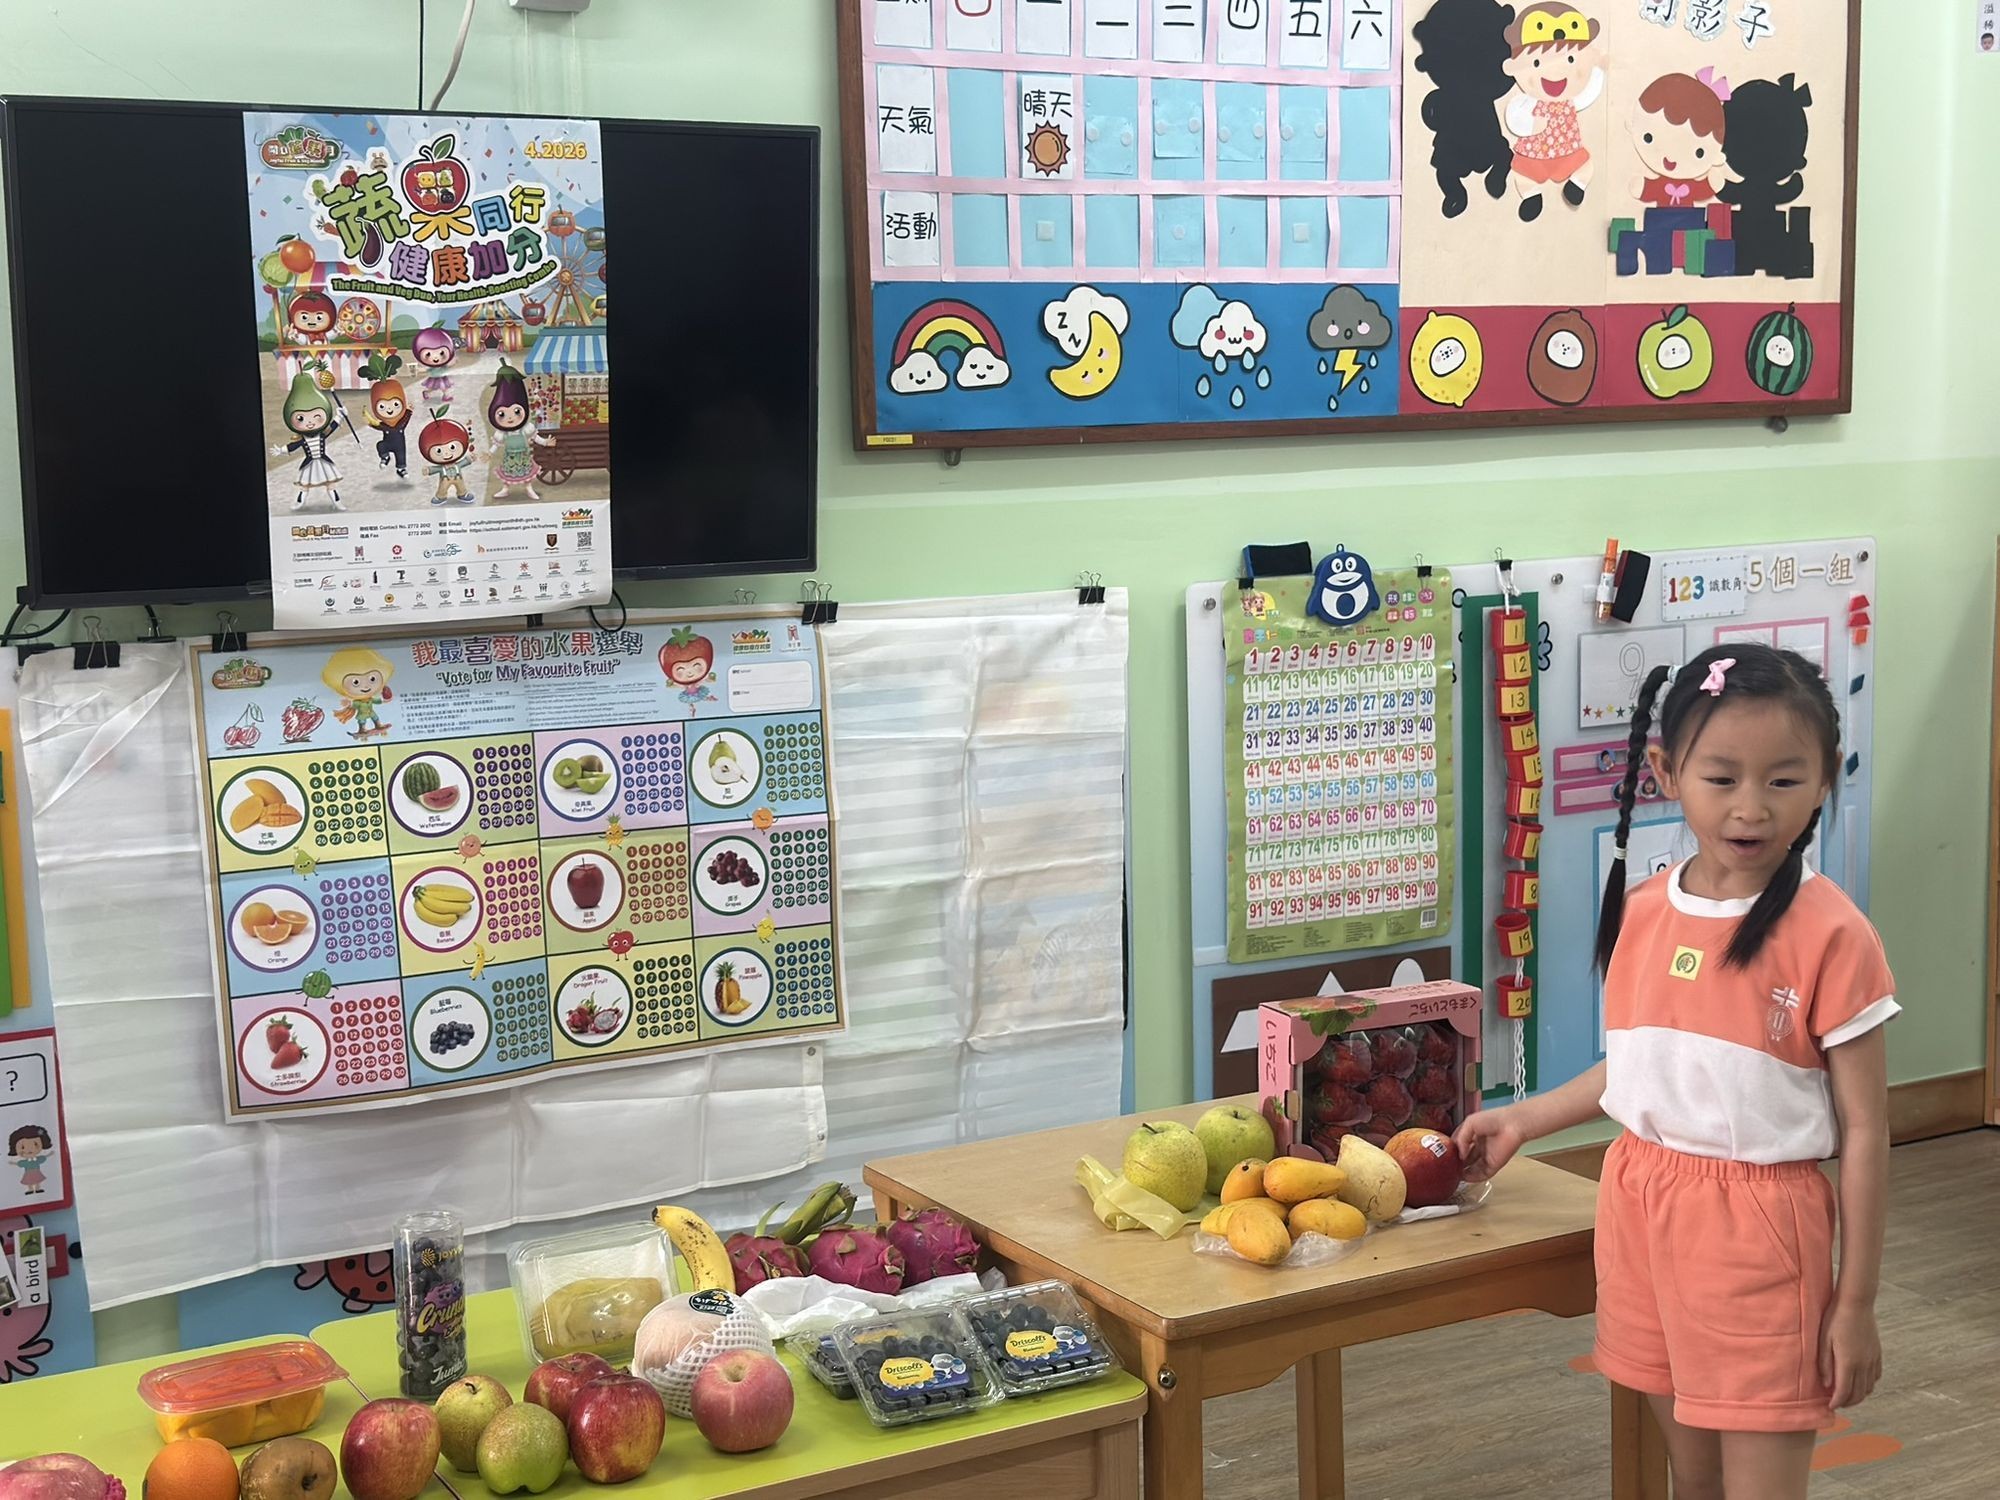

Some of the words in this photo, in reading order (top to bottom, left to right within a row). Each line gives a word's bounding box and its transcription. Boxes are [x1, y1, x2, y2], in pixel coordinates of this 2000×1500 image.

[1227, 0, 1260, 29] 四
[1289, 0, 1322, 37] 五
[1352, 0, 1382, 40] 六
[1024, 90, 1072, 119] 晴天
[879, 105, 934, 135] 天氣
[525, 142, 587, 160] 4.2026
[321, 163, 546, 262] 蔬果同行
[886, 212, 938, 241] 活動
[388, 226, 543, 286] 健康加分
[332, 278, 350, 290] The
[352, 280, 376, 292] Fruit
[376, 282, 394, 295] and
[395, 284, 413, 300] Veg
[436, 289, 456, 303] Your
[528, 260, 557, 284] Combo
[1669, 575, 1704, 603] 123
[411, 630, 643, 668] 我最喜愛的水果選舉
[1250, 649, 1257, 664] 1
[1271, 647, 1280, 662] 2
[1290, 646, 1299, 661] 3
[1309, 644, 1319, 659] 4
[1328, 643, 1337, 658] 5
[1348, 641, 1356, 656] 6
[1367, 640, 1376, 655] 7
[1385, 638, 1394, 653] 8
[1404, 637, 1412, 652] 9
[1420, 635, 1432, 650] 10
[473, 668, 493, 682] for
[496, 665, 520, 683] My
[521, 662, 582, 680] Favourite
[1514, 656, 1528, 673] 12
[1619, 642, 1645, 700] 9
[1511, 692, 1525, 708] 13
[1246, 733, 1259, 749] 31
[1267, 731, 1280, 747] 32
[1286, 729, 1299, 745] 33
[1306, 727, 1319, 744] 34
[1325, 725, 1338, 741] 35
[1345, 724, 1357, 740] 36
[1364, 722, 1377, 738] 37
[1383, 721, 1395, 736] 38
[1401, 719, 1413, 734] 39
[1420, 717, 1432, 732] 40
[1520, 728, 1534, 745] 14
[1250, 902, 1263, 919] 91
[1271, 900, 1284, 916] 92
[1290, 898, 1303, 913] 93
[1309, 896, 1322, 912] 94
[1328, 893, 1341, 908] 95
[1347, 891, 1361, 906] 96
[1367, 888, 1380, 904] 97
[1386, 886, 1399, 901] 98
[1405, 884, 1418, 899] 99
[1423, 881, 1436, 897] 100
[1519, 932, 1531, 949] 19
[430, 1004, 462, 1015] Blueberries
[1408, 997, 1477, 1018] くまもといちご
[1516, 998, 1530, 1011] 20
[1266, 1020, 1277, 1087] いちご
[6, 1070, 18, 1092] ?
[270, 1078, 307, 1088] Strawberries
[26, 1260, 38, 1288] bird
[30, 1292, 40, 1303] a
[1010, 1335, 1046, 1347] Driscoll's
[885, 1362, 923, 1374] Driscoll's
